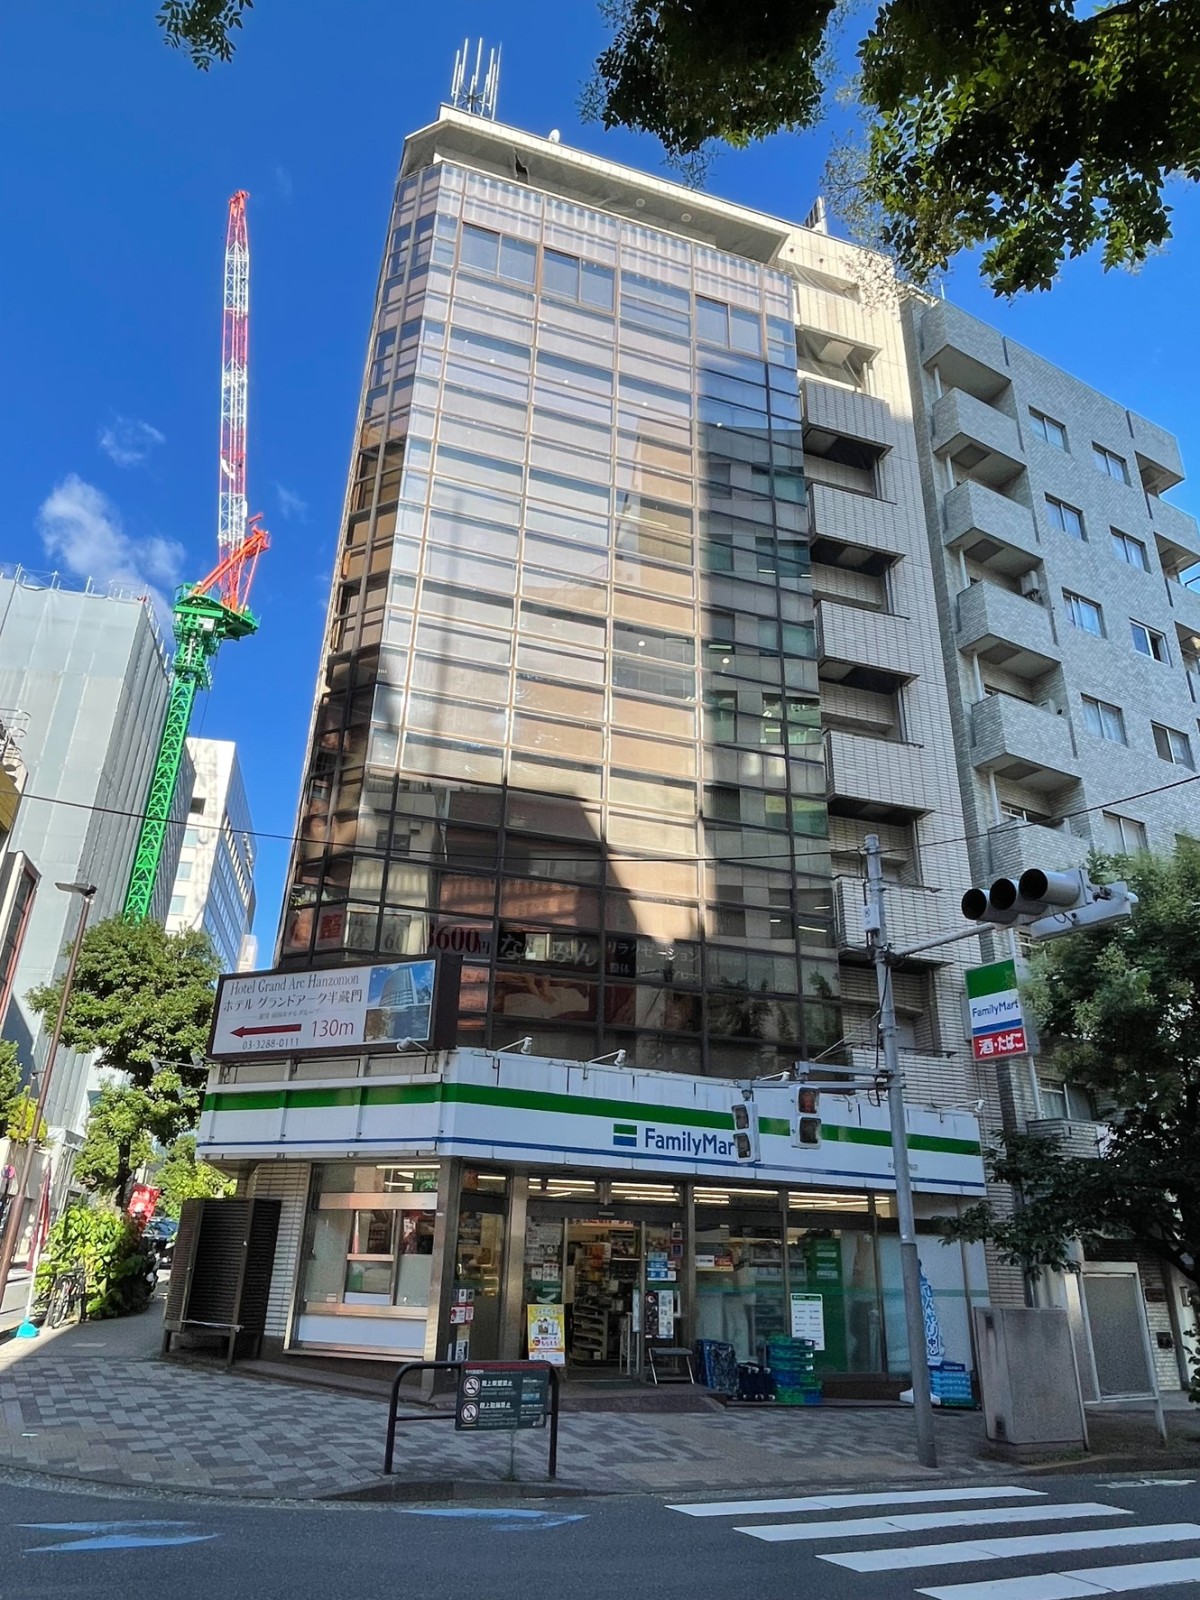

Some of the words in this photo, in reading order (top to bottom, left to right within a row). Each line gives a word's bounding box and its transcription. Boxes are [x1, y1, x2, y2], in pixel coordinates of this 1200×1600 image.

[230, 981, 255, 996] Hotel
[258, 977, 286, 993] Grand
[288, 977, 305, 990] Arc
[308, 974, 359, 989] Hanzomon
[972, 1000, 1019, 1017] FamilyMart
[312, 1019, 354, 1038] 130m
[242, 1038, 299, 1050] 03-3288-0111
[645, 1127, 736, 1156] FamilyMar
